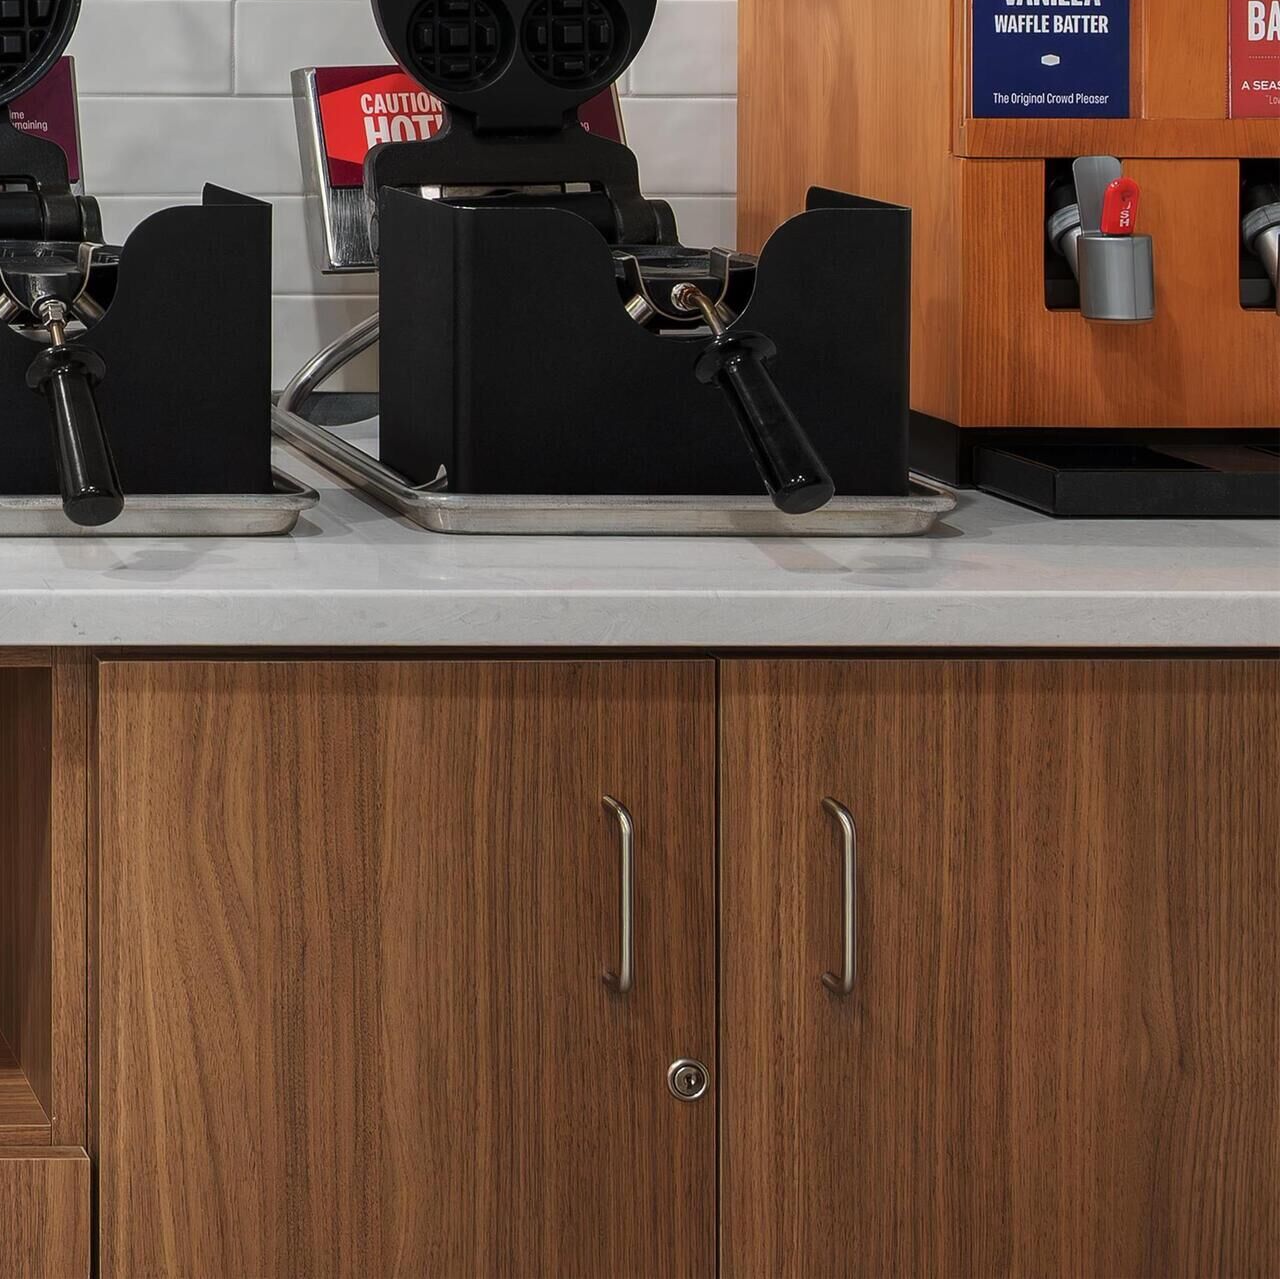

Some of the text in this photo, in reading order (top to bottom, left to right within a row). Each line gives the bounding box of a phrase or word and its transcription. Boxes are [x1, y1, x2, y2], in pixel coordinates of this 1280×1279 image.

[994, 14, 1109, 33] WAFFLE BATTER
[1241, 80, 1250, 90] A
[993, 92, 1109, 107] The Original Crowd Pleaser
[12, 120, 48, 132] maining
